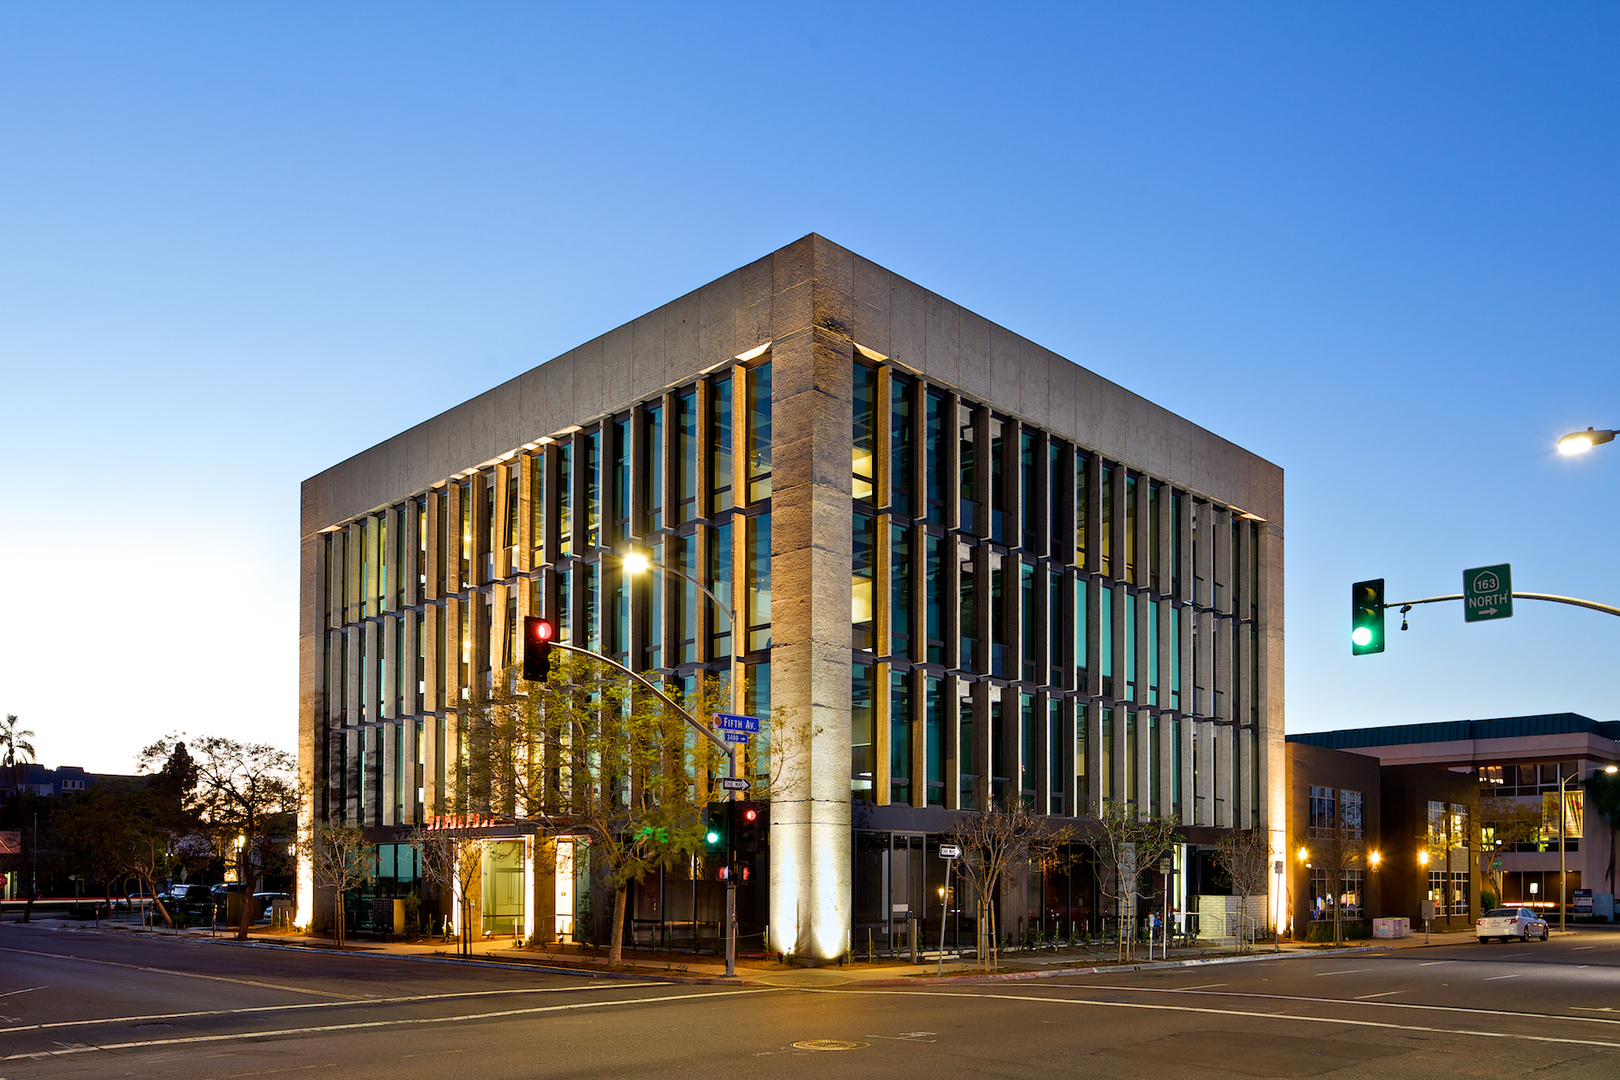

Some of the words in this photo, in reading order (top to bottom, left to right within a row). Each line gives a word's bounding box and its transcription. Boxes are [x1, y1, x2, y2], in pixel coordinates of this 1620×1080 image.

[1477, 578, 1496, 590] 163
[1469, 593, 1508, 608] NORTH
[723, 717, 743, 728] FIFTH
